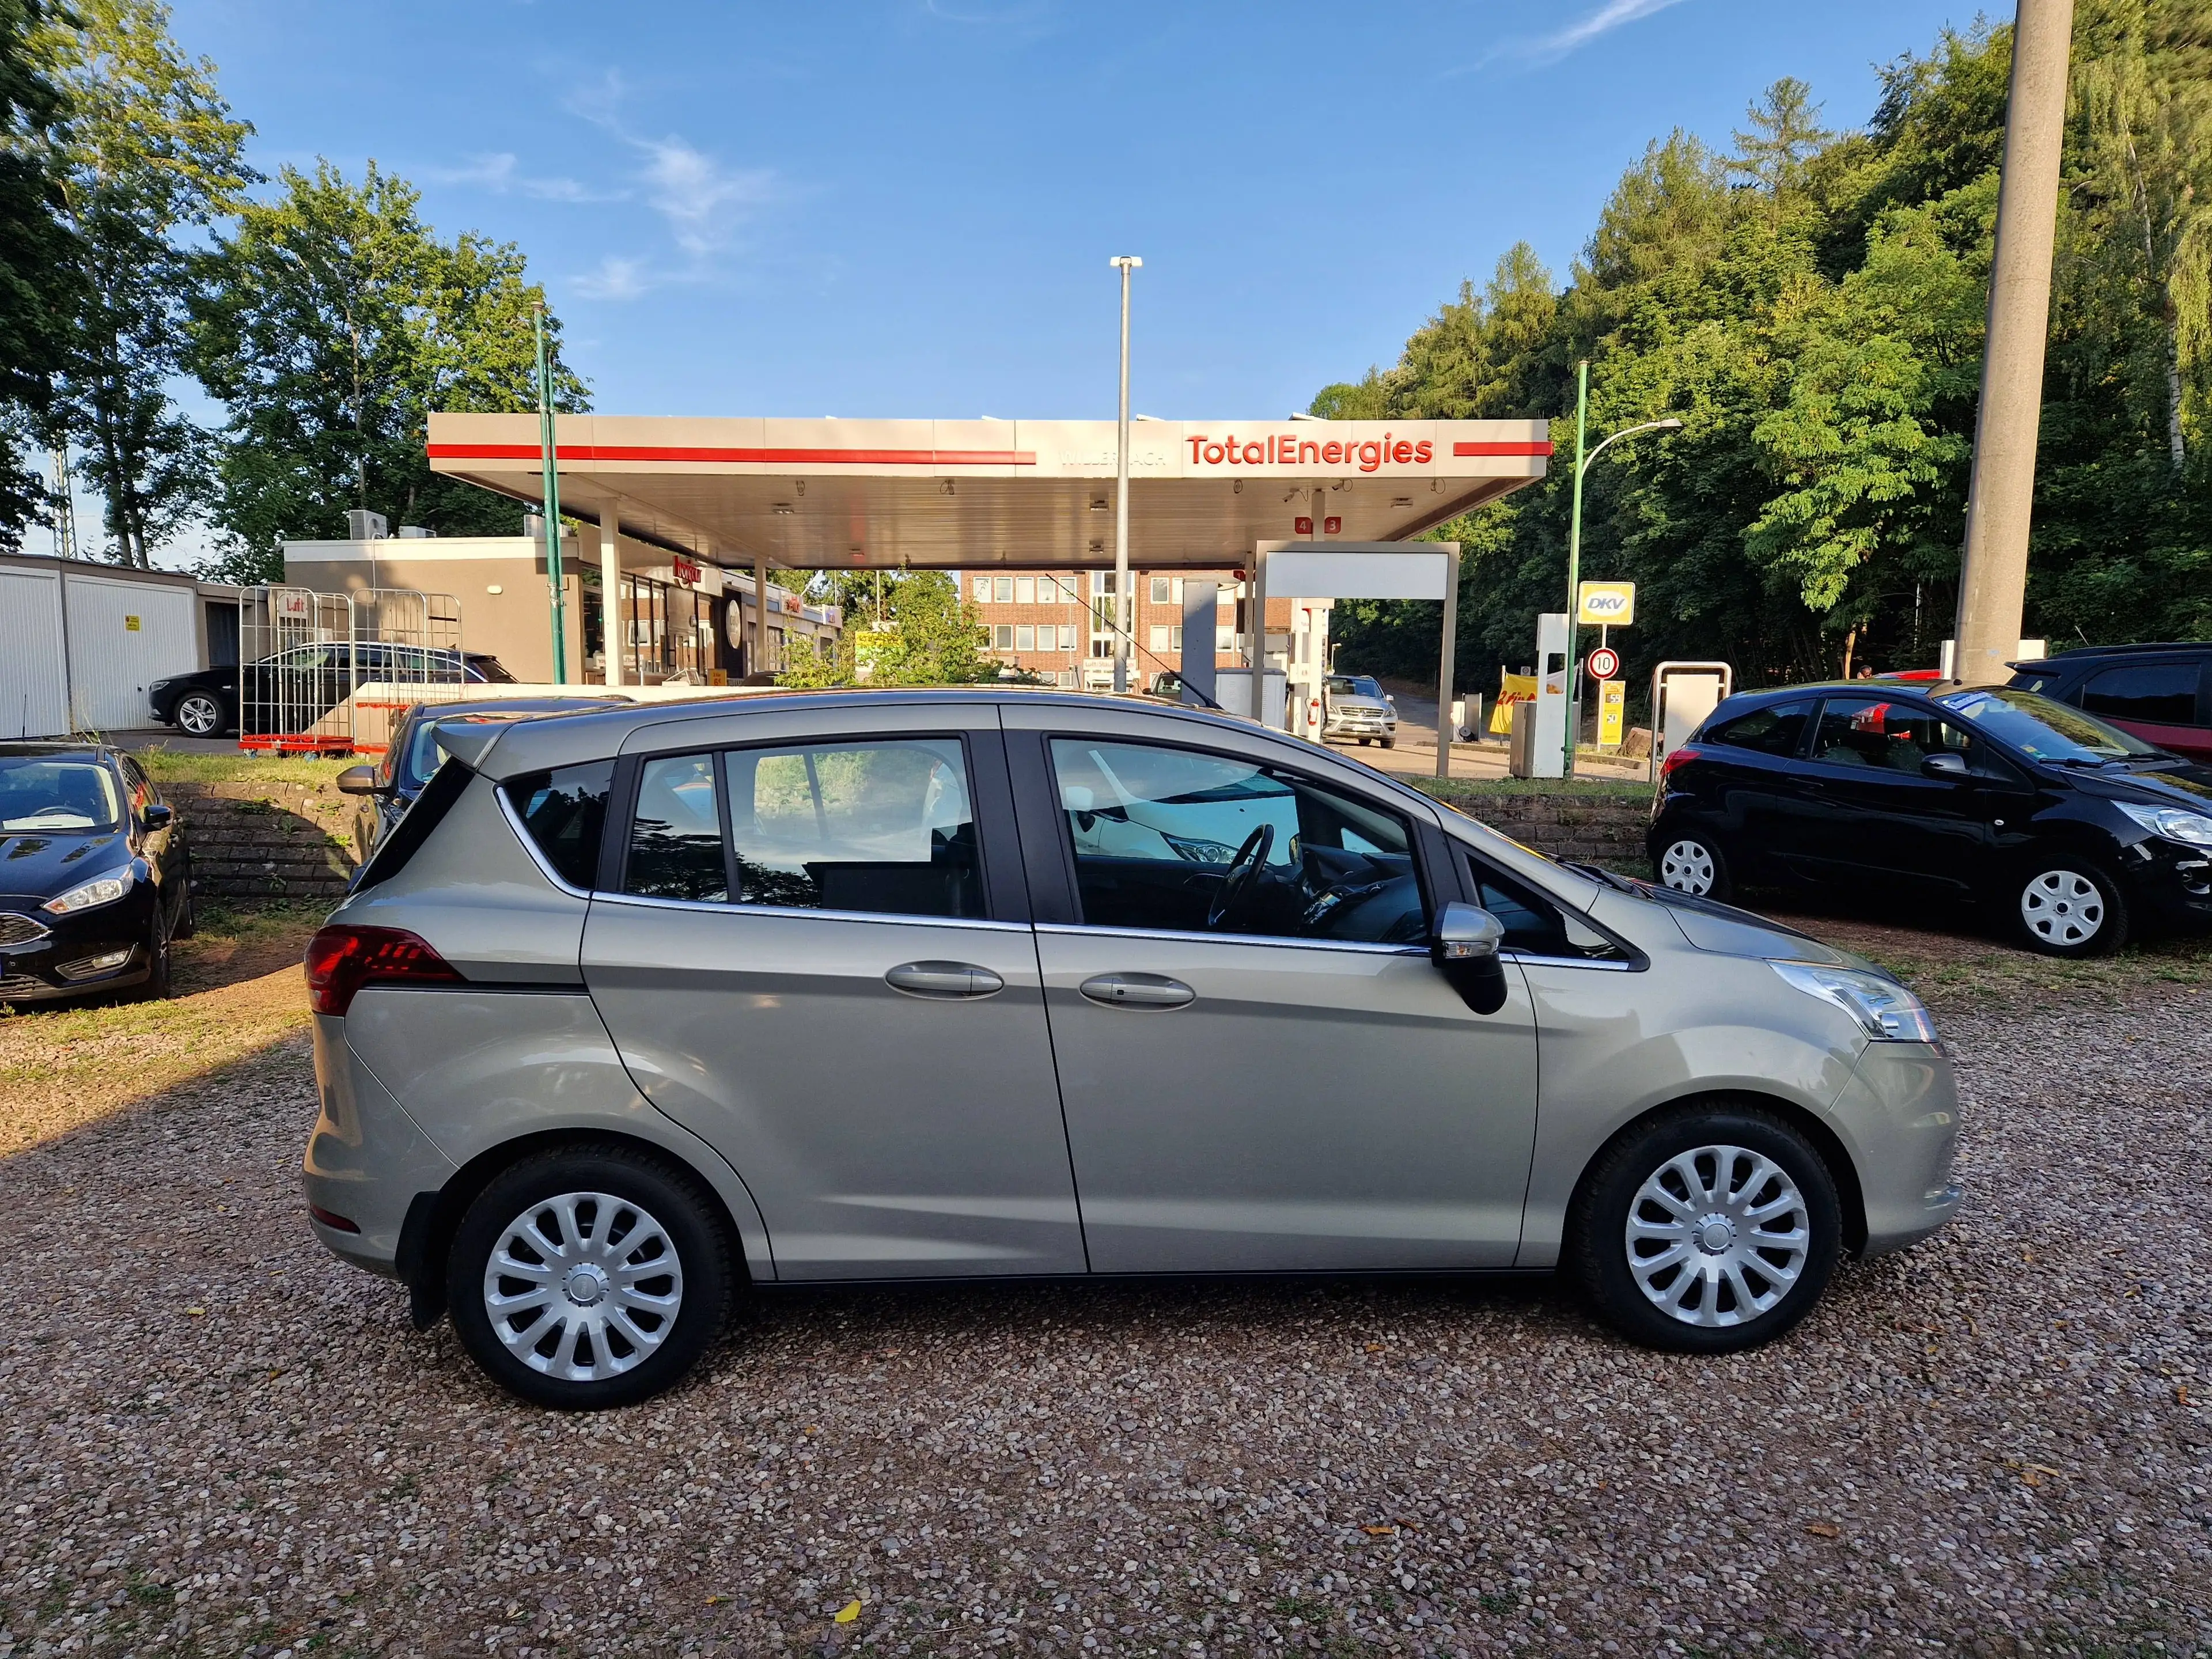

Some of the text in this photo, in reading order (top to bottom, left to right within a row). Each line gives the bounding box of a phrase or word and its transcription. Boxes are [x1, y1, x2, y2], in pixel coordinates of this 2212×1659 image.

[1185, 432, 1433, 472] TotalEnergies
[1299, 520, 1307, 531] 4
[1330, 520, 1336, 531] 3
[1588, 598, 1626, 609] DKV
[1597, 657, 1611, 670] 10
[1496, 691, 1508, 705] 2
